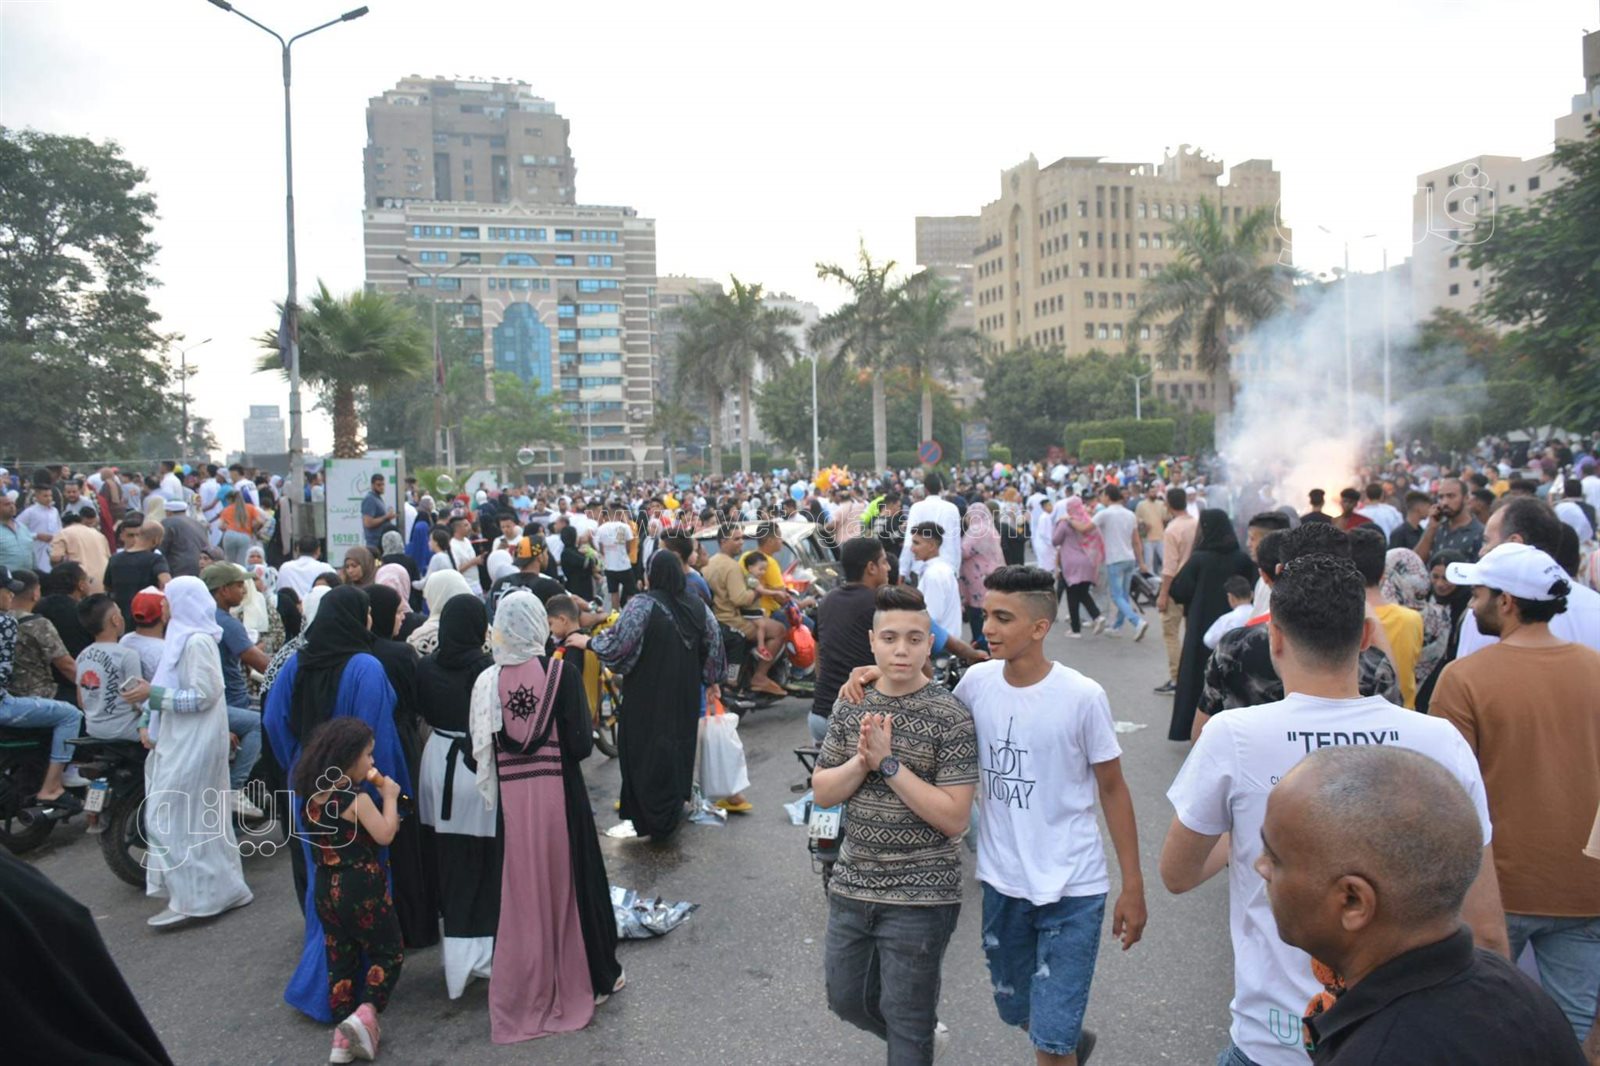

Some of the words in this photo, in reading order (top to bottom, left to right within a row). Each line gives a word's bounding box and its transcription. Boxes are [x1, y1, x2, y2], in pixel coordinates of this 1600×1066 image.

[332, 532, 361, 543] 16183
[989, 743, 1028, 777] NOT
[983, 768, 1036, 810] TODAY
